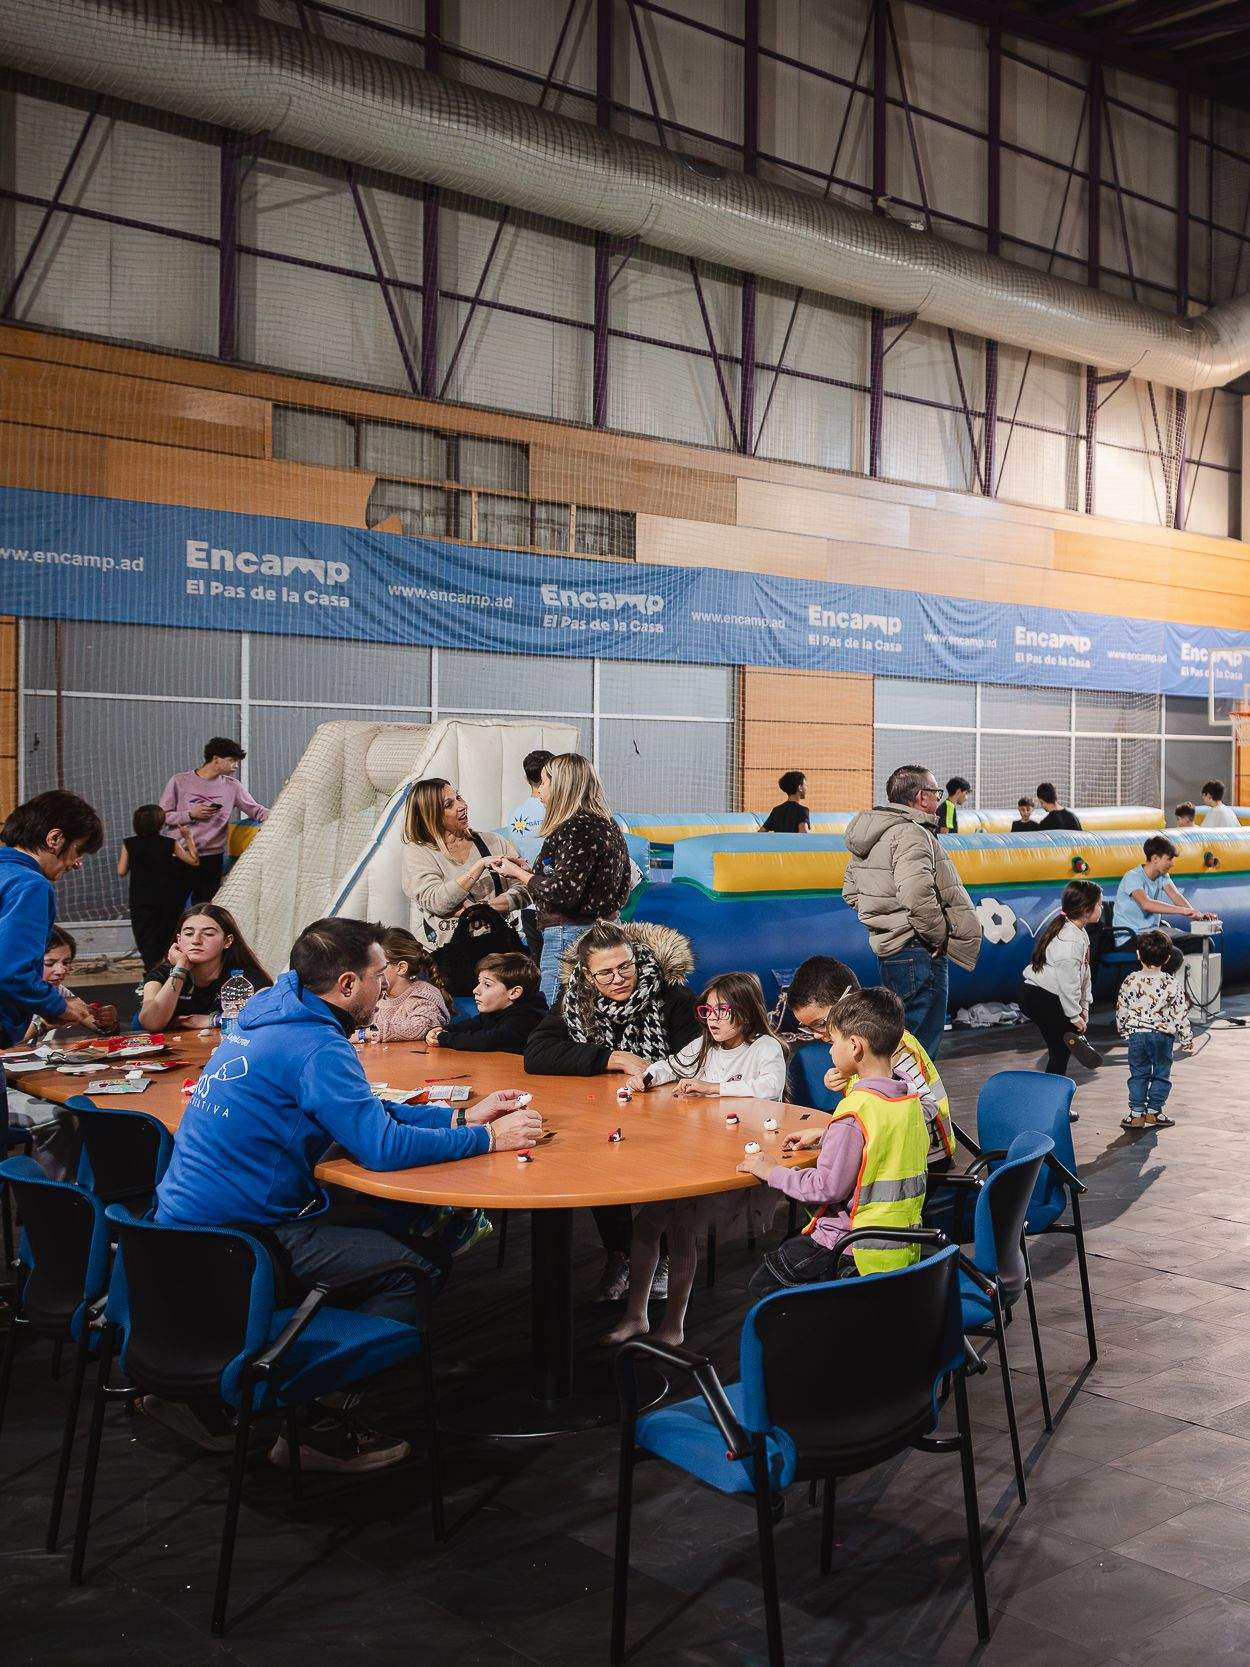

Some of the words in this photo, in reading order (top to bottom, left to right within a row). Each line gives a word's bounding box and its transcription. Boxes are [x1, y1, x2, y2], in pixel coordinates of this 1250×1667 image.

[186, 540, 350, 585] Encamp
[186, 579, 205, 595] El
[210, 582, 246, 598] Pas
[250, 586, 277, 601] de
[282, 587, 299, 603] la
[304, 590, 350, 607] Casa
[388, 584, 513, 609] www.encamp.ad
[540, 584, 665, 615] Encamp
[543, 615, 558, 628] El
[560, 616, 587, 630] Pas
[590, 618, 610, 631] de
[614, 618, 627, 632] la
[630, 620, 664, 633] Casa
[691, 611, 786, 629] www.encamp.ad
[808, 604, 902, 636] Encamp
[808, 634, 820, 646] El
[822, 635, 842, 647] Pas
[844, 637, 860, 649] de
[862, 638, 872, 650] la
[874, 639, 902, 652] Casa
[1014, 625, 1091, 653] Encamp
[1014, 652, 1025, 663] El
[1025, 653, 1043, 664] Pas
[1043, 655, 1057, 666] de
[1057, 654, 1068, 666] la
[1068, 656, 1091, 669] Casa
